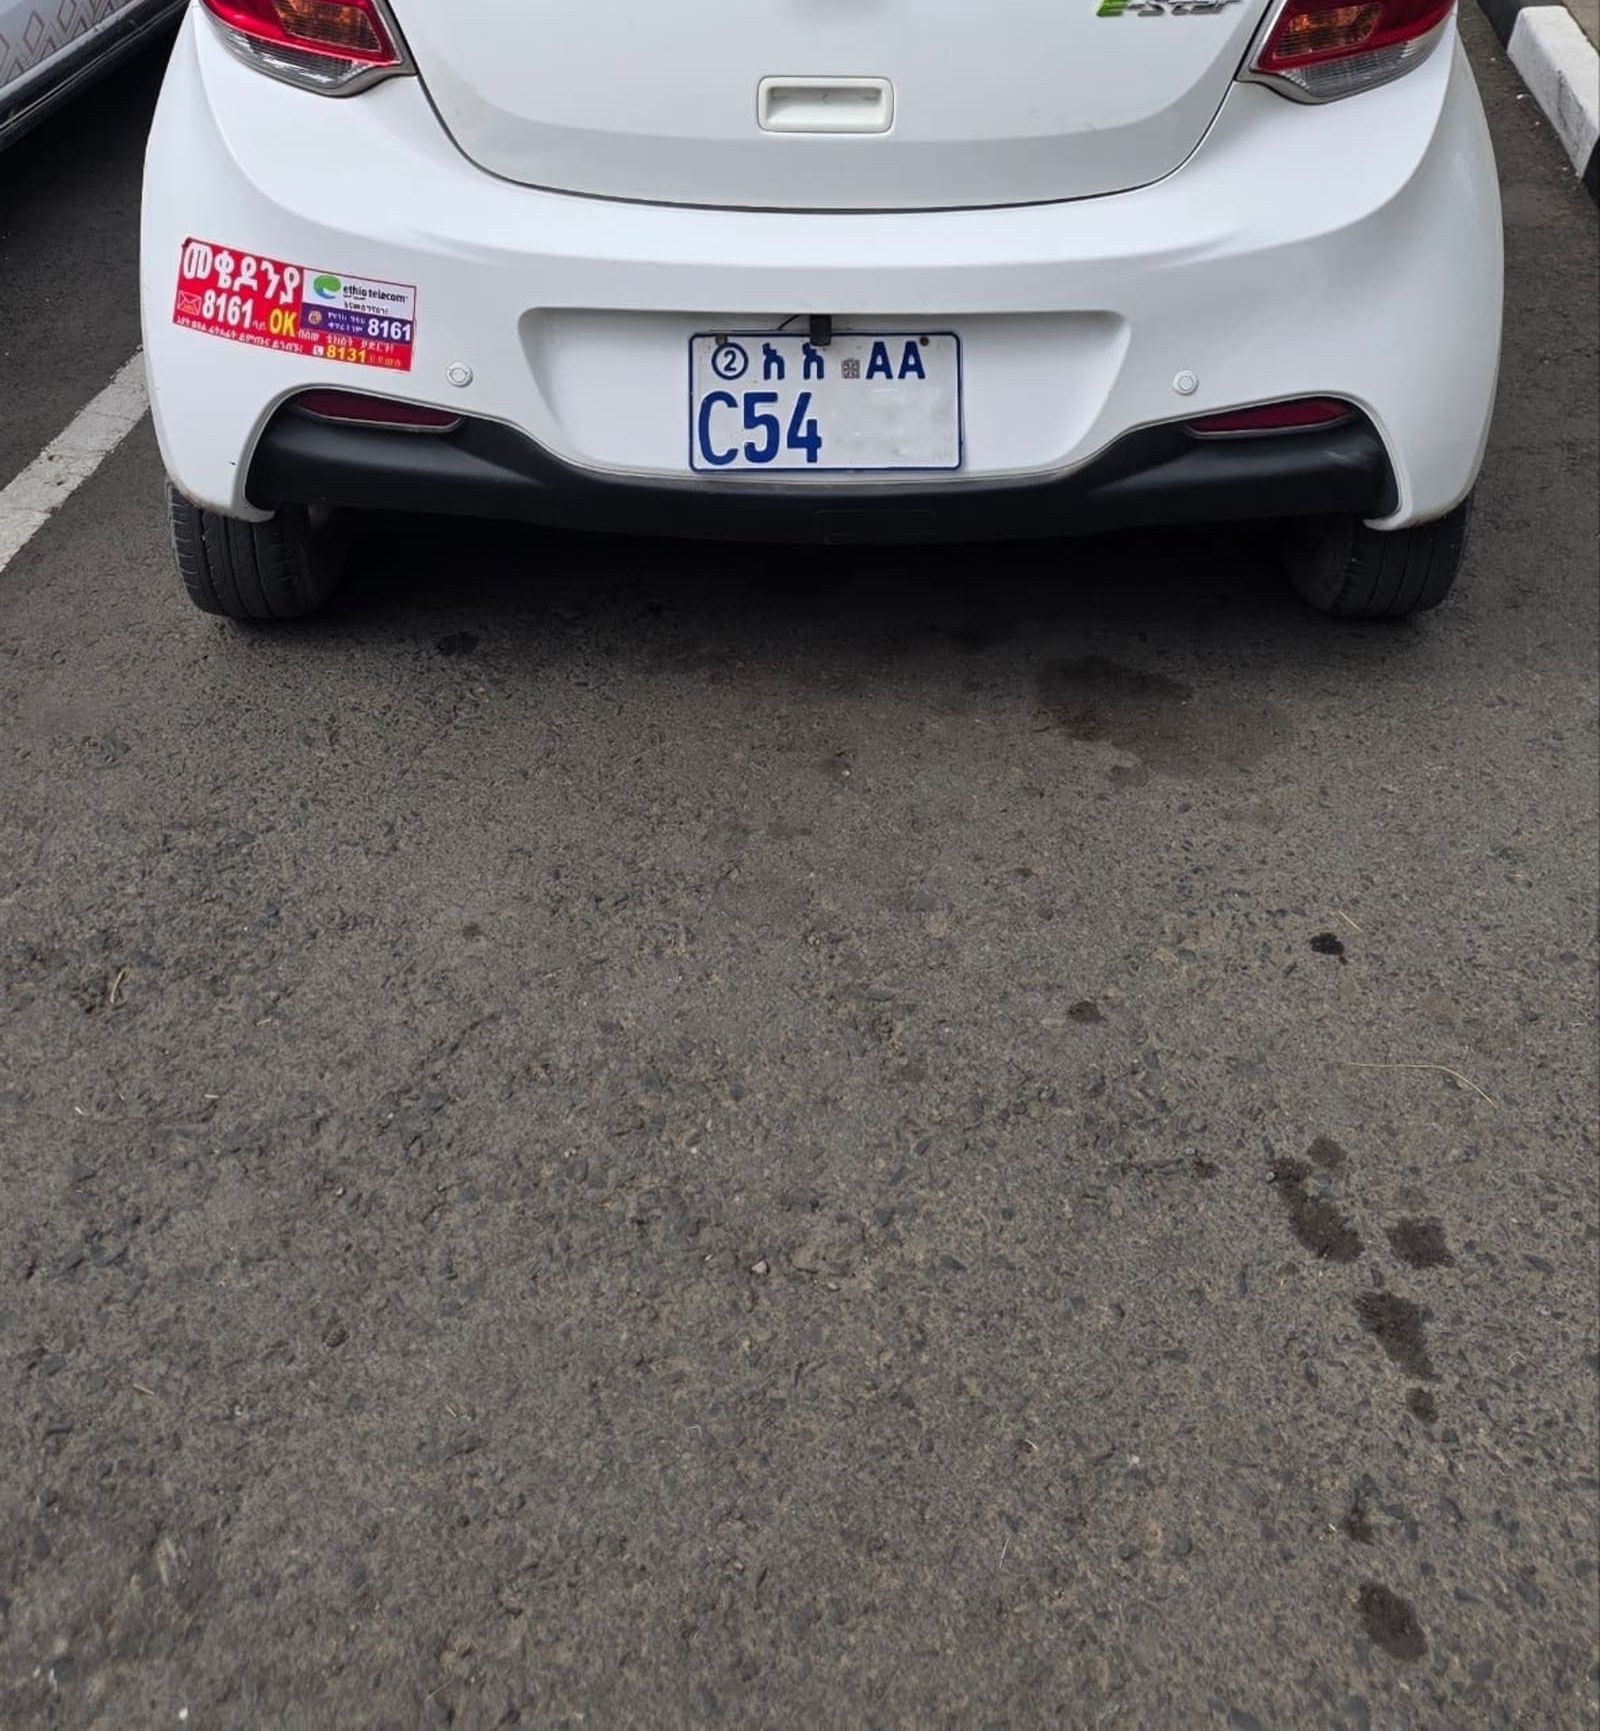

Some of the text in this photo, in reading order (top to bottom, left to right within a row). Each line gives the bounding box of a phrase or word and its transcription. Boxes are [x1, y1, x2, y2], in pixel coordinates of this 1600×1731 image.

[343, 284, 367, 297] ethio
[368, 289, 406, 303] telecom
[202, 290, 254, 330] 8161
[269, 306, 298, 337] OK
[368, 318, 411, 341] 8161
[326, 344, 367, 363] 8131
[865, 340, 926, 380] AA
[698, 390, 822, 465] C54
